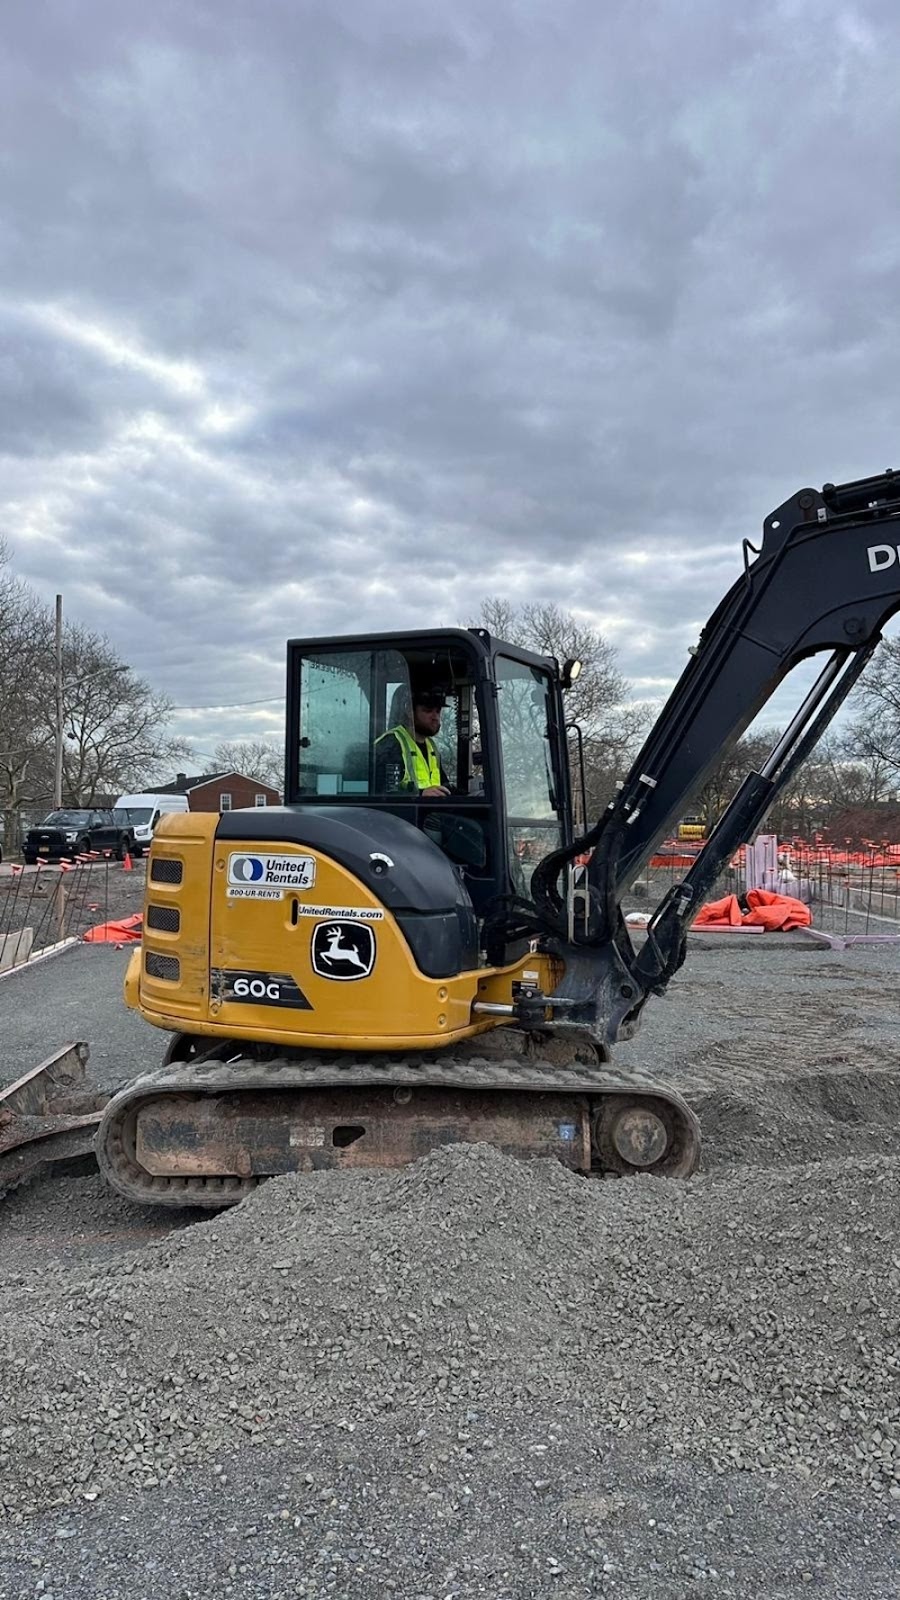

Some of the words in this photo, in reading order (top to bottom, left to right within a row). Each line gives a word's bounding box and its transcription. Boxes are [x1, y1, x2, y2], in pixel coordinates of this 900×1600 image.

[867, 544, 900, 573] D
[266, 859, 306, 873] United
[265, 872, 309, 885] Rentals
[229, 889, 281, 899] 800-UR-RENTS
[299, 906, 383, 919] UnitedRentals.com
[233, 978, 280, 1000] 60G
